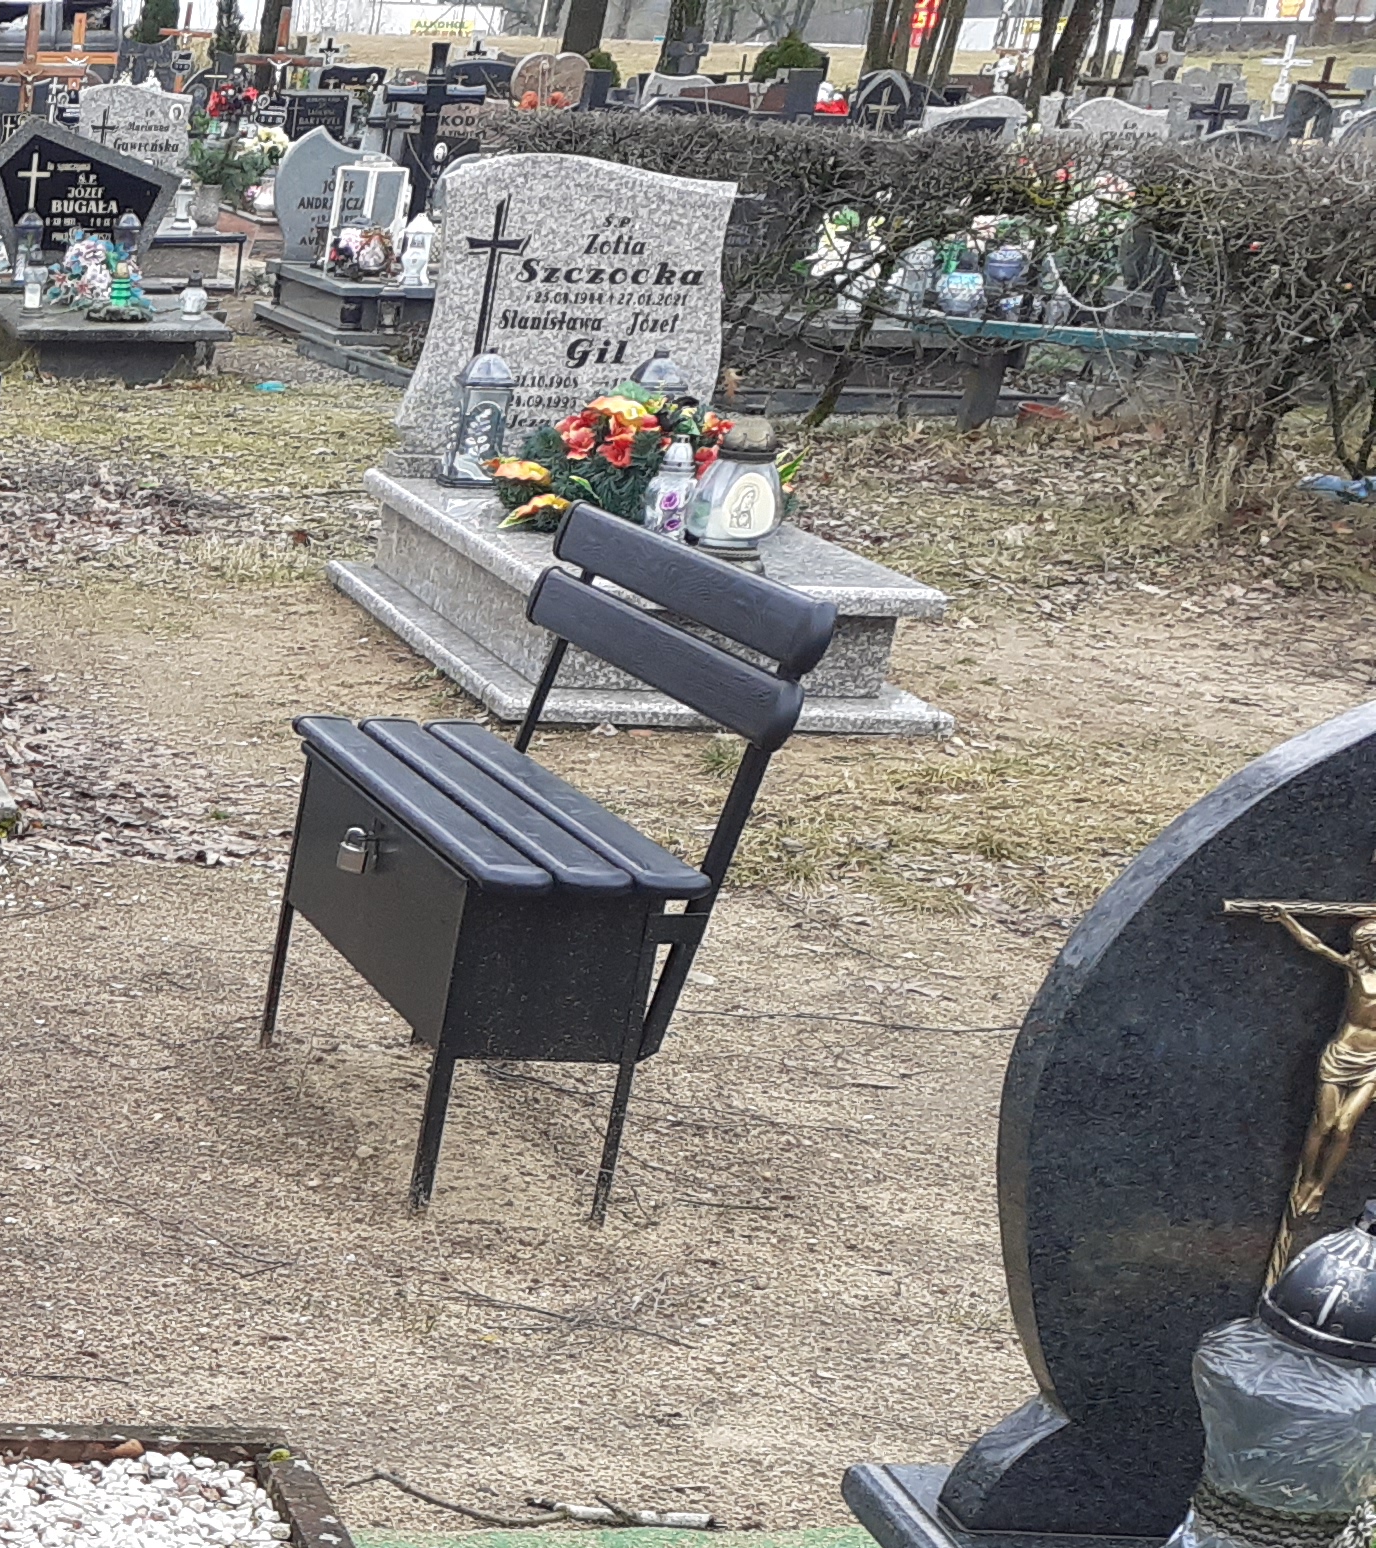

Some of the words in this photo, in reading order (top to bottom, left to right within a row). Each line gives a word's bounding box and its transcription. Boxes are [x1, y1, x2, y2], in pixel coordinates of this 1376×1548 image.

[67, 185, 106, 198] JÓZEF
[323, 179, 355, 194] JÓEF
[51, 200, 118, 214] BUGAŁA
[584, 233, 647, 255] Zofia
[516, 258, 705, 286] Szczocka
[498, 309, 604, 331] Stanisława
[626, 312, 680, 336] Józef
[565, 338, 628, 369] Gil
